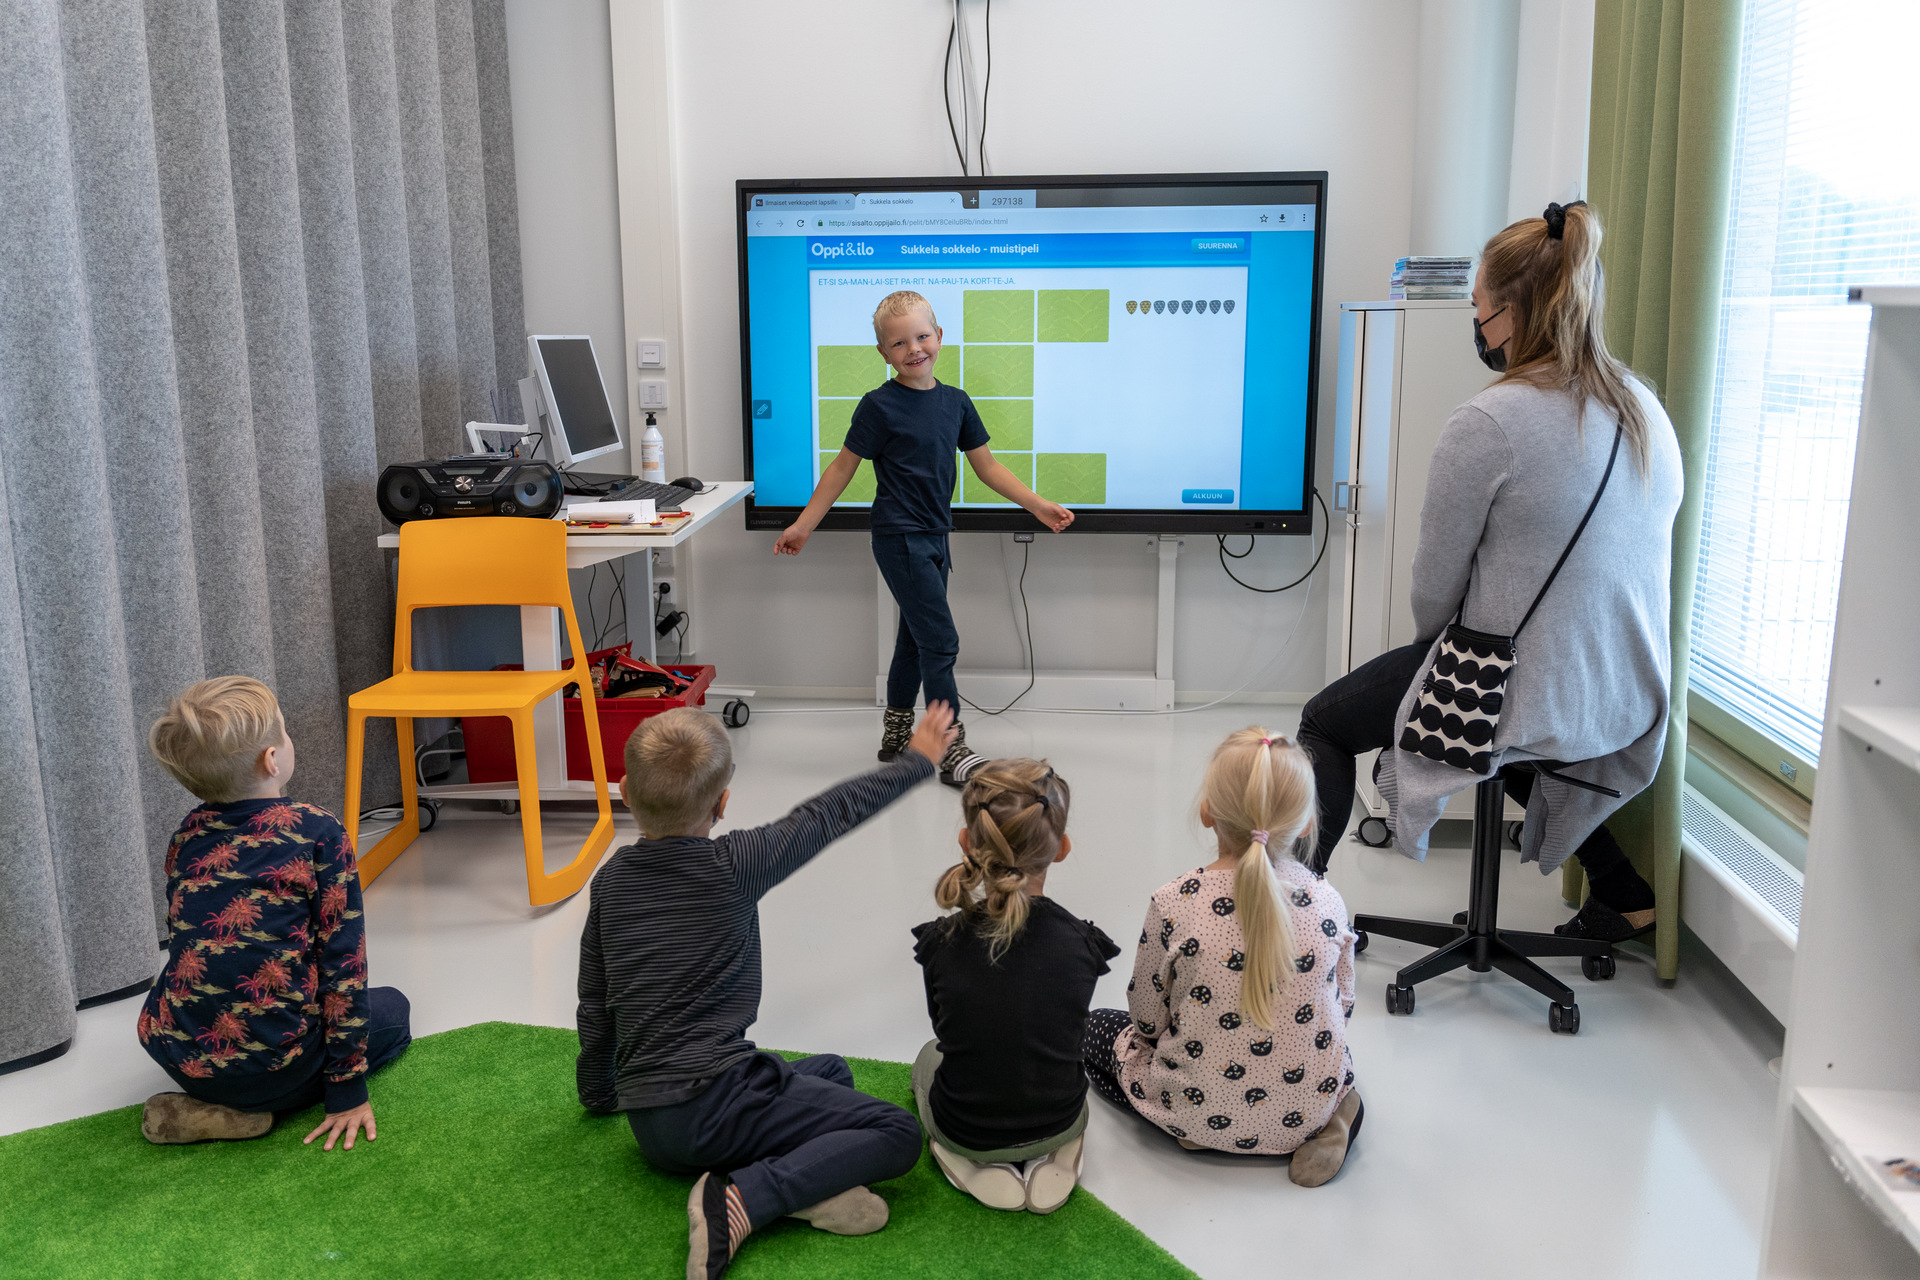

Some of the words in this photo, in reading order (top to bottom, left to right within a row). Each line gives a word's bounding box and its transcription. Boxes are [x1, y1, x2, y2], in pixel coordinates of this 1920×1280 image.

[788, 199, 818, 207] verkkopelit
[892, 197, 914, 205] sokkelo
[991, 197, 1023, 206] 297138
[811, 242, 875, 259] Oppi&ilo
[900, 245, 940, 255] Sukkela
[942, 244, 981, 254] sokkelo
[990, 243, 1039, 256] muistipeli
[818, 278, 837, 286] ET-SI
[838, 278, 899, 286] SA-MAN-LAI-SET
[928, 277, 969, 285] NA-PAU-TA
[971, 277, 1016, 285] KORT-TE-JA.
